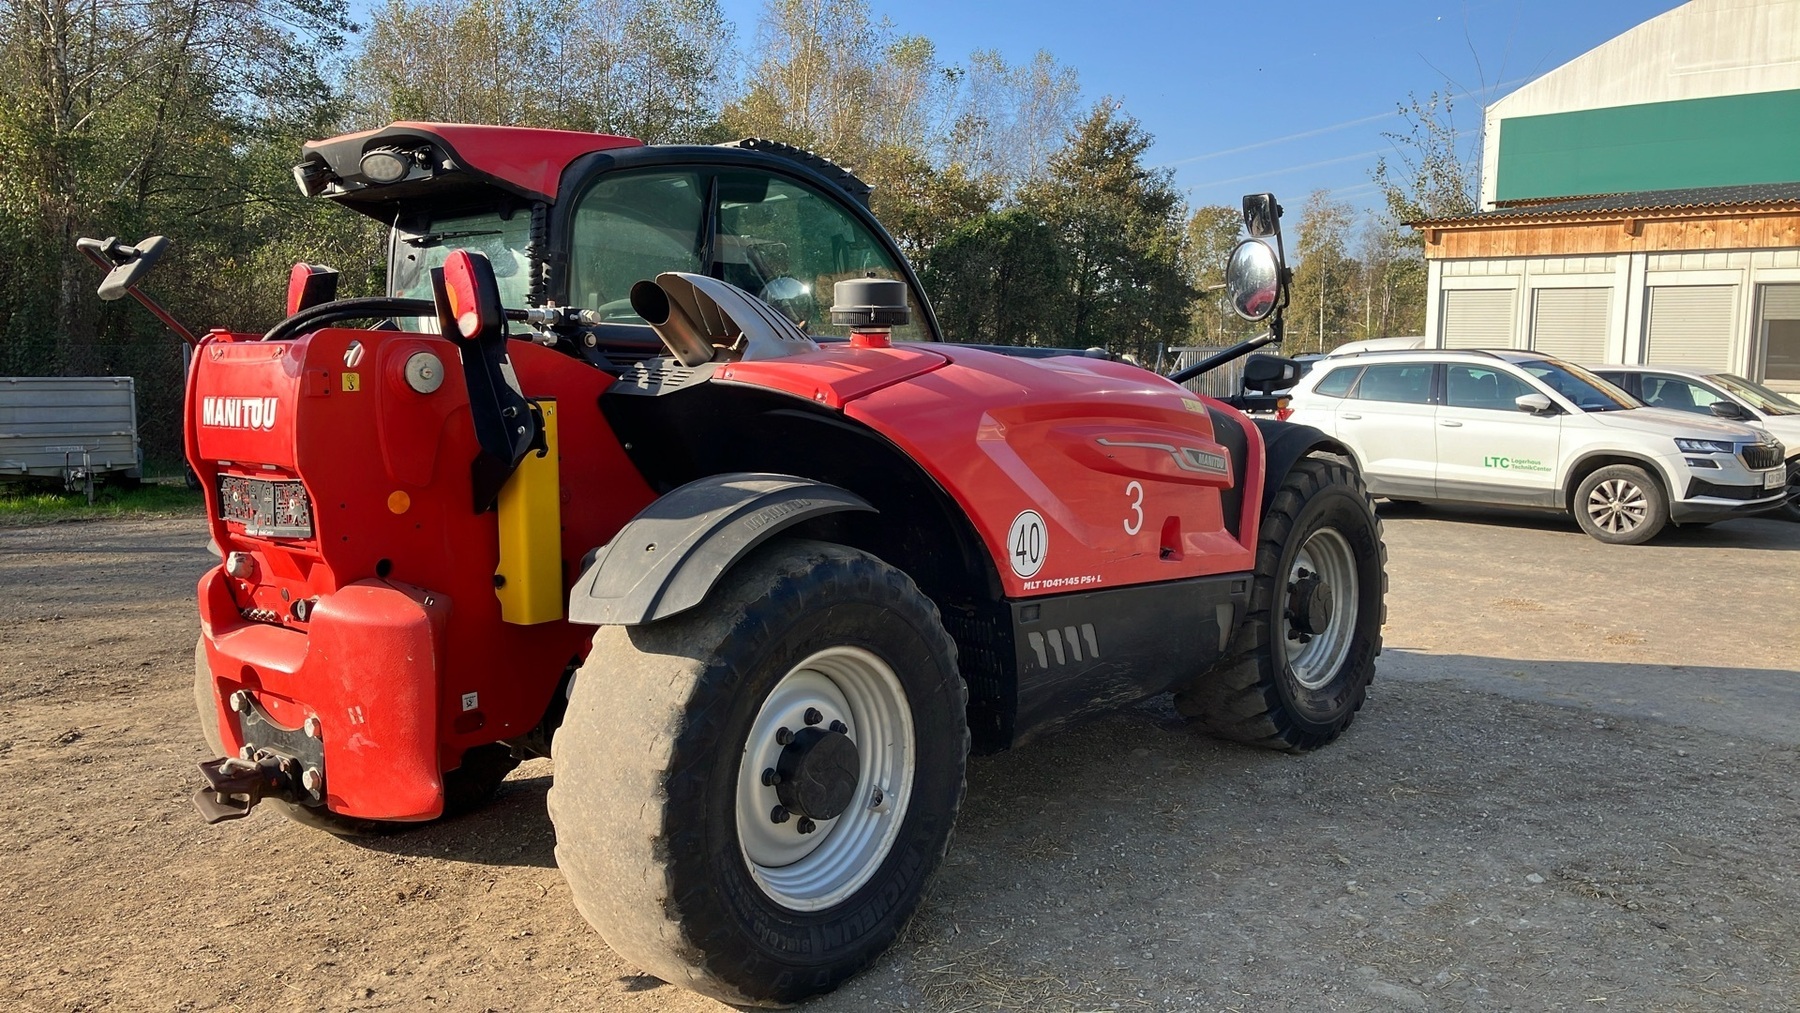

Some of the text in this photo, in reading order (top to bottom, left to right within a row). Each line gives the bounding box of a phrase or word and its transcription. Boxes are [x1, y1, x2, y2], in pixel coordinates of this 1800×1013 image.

[203, 396, 279, 431] MANITOU
[1198, 453, 1225, 469] MANITOU
[1484, 456, 1510, 468] LTC
[744, 498, 812, 531] MANITOU
[1123, 480, 1144, 536] 3
[1015, 522, 1040, 566] 40
[1023, 574, 1102, 590] MLT 1041-145 PS+ L
[823, 842, 923, 951] MICHELIN
